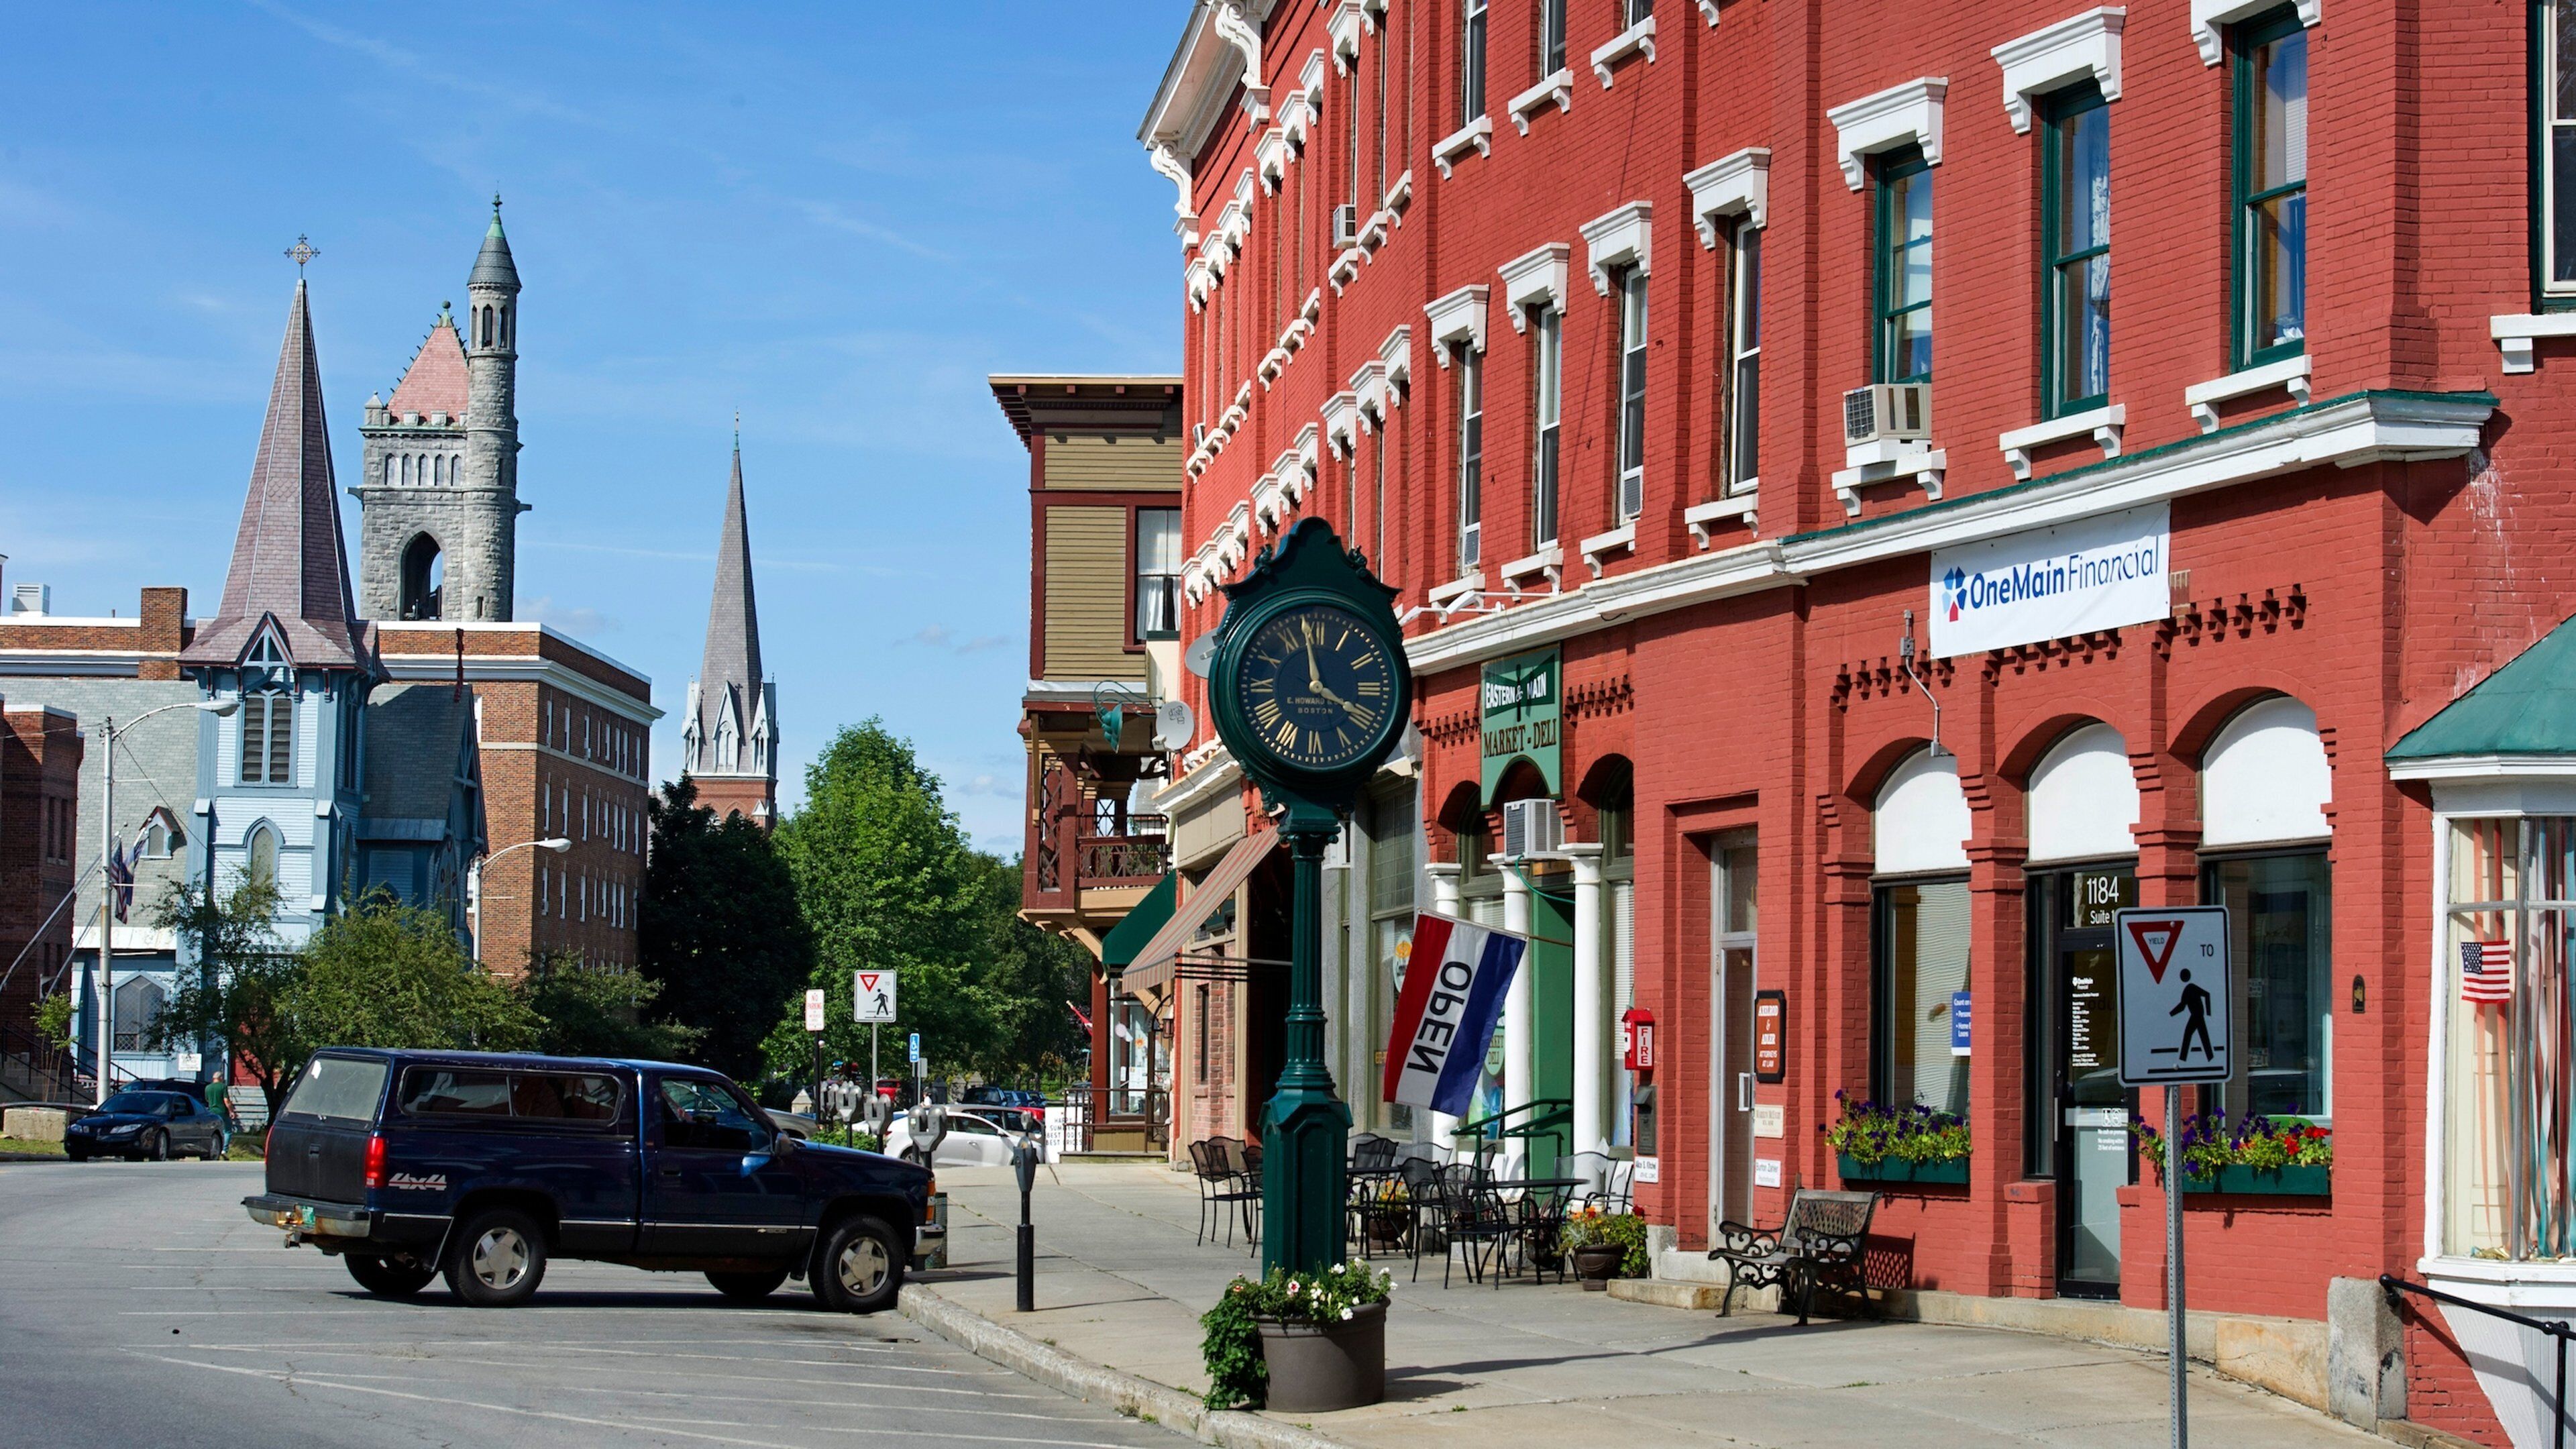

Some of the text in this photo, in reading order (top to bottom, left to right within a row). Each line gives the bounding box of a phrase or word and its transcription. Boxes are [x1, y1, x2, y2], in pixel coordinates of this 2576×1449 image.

[1970, 536, 2159, 609] OneMain Financial
[1486, 672, 1546, 708] EASTERN & MAIN
[1484, 724, 1525, 758] MARKET
[1533, 718, 1556, 749] DELI
[2087, 876, 2119, 904] 1184
[2090, 910, 2110, 924] Suite
[2200, 944, 2214, 957] TO
[1488, 1051, 1499, 1065] DELI
[388, 1173, 447, 1191] 4x4
